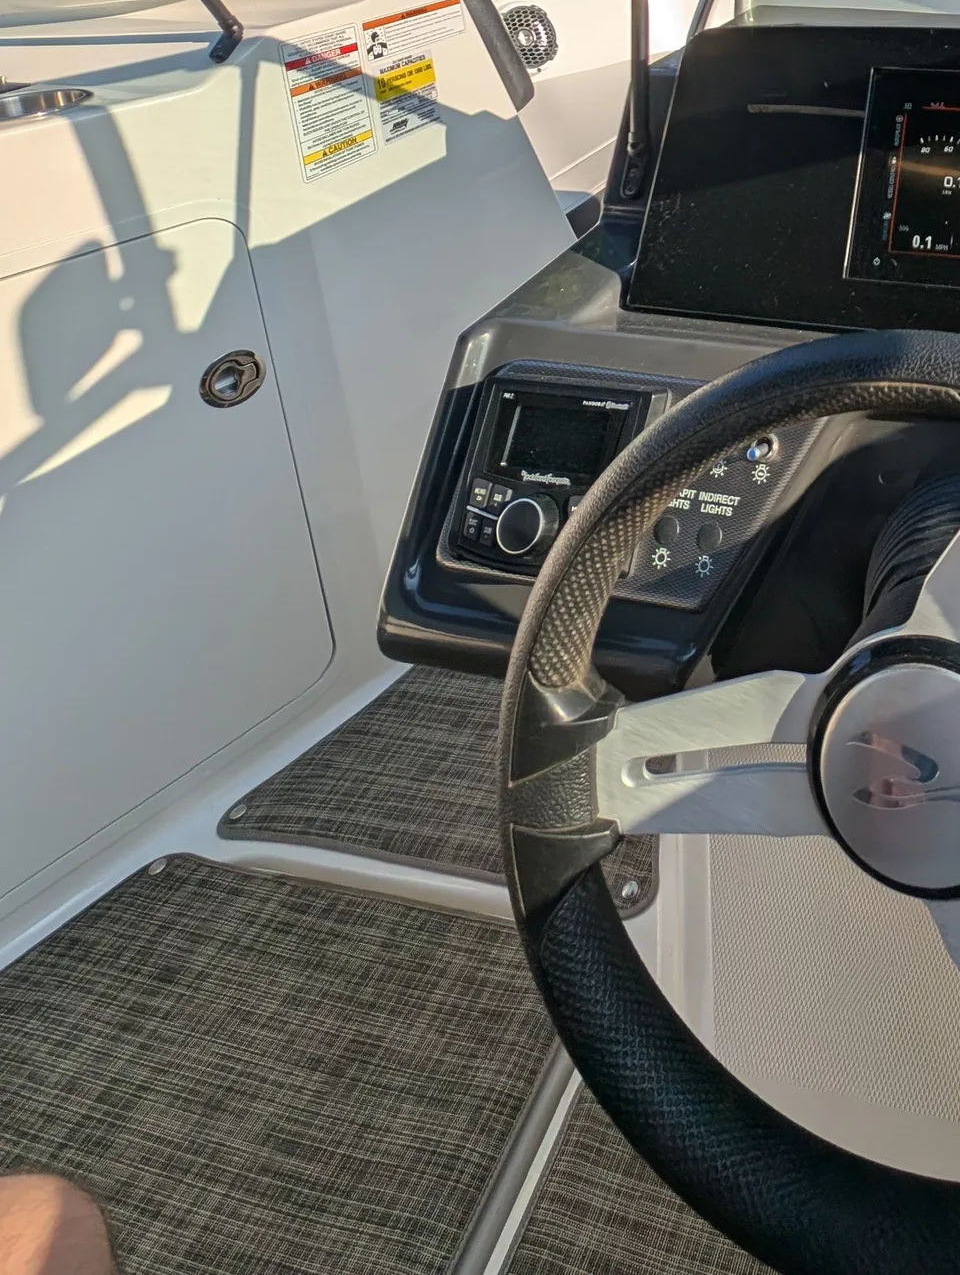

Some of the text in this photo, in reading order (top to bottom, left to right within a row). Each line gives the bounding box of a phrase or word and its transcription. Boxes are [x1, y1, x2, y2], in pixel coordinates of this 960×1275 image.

[311, 48, 341, 63] DANGER
[379, 62, 401, 74] MAXIMUM
[401, 54, 425, 67] CAPACITIES
[377, 77, 386, 90] 10
[385, 72, 406, 84] PERSONS
[328, 136, 357, 154] CAUTION
[912, 235, 932, 250] 0.1
[699, 491, 741, 506] INDIRECT
[701, 503, 733, 517] LIGHTS
